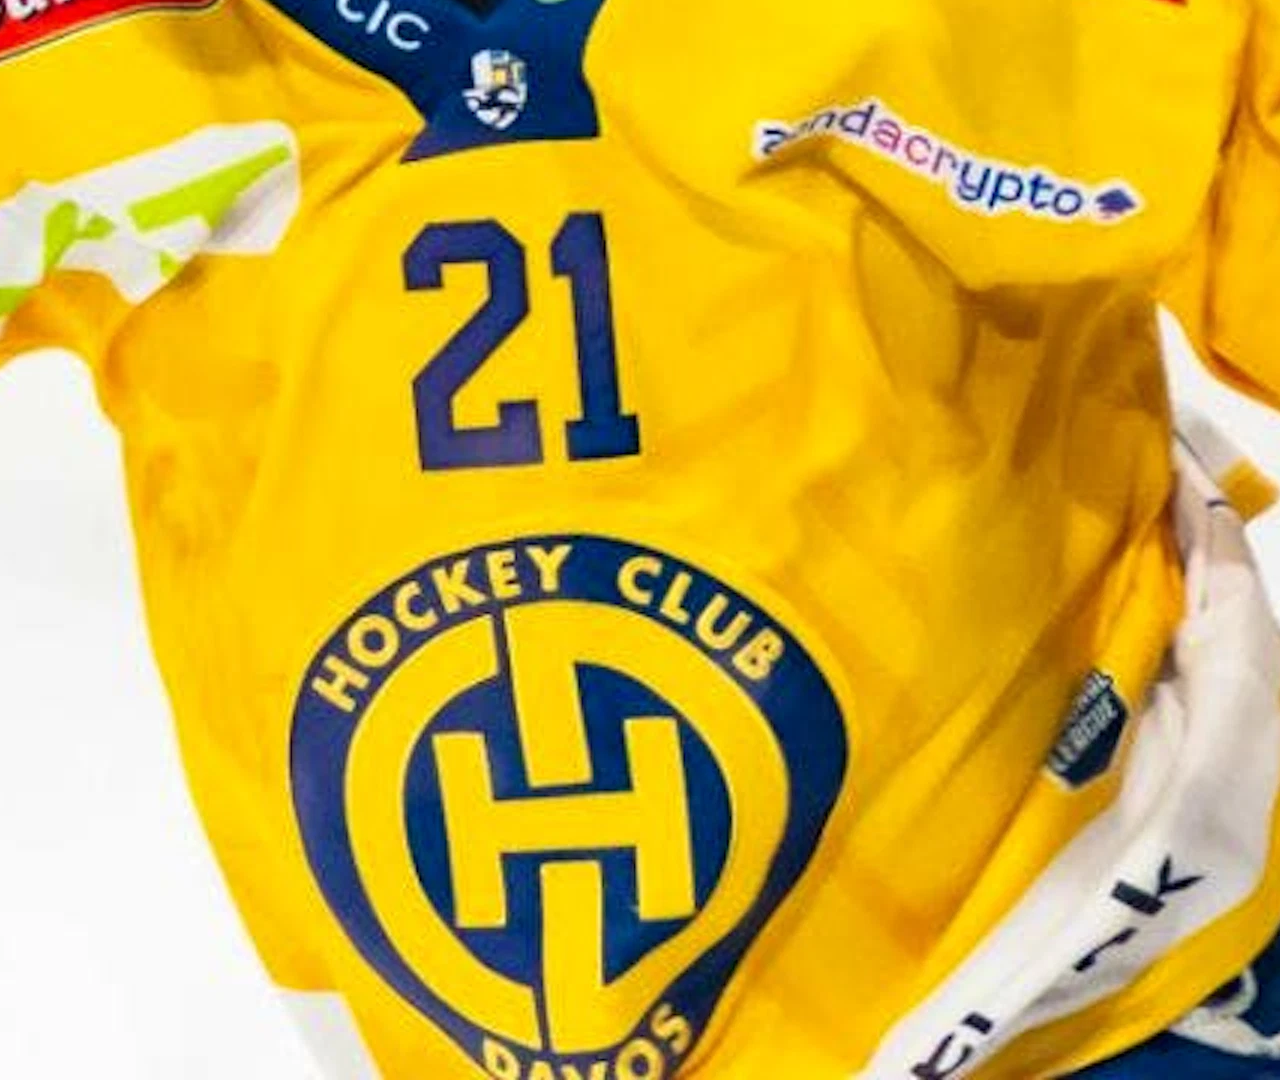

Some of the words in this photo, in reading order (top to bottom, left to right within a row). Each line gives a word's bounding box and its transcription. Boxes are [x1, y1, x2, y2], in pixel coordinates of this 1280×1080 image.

[402, 210, 641, 472] 21
[310, 544, 573, 714] HOCKEY
[617, 556, 786, 681] CLUB
